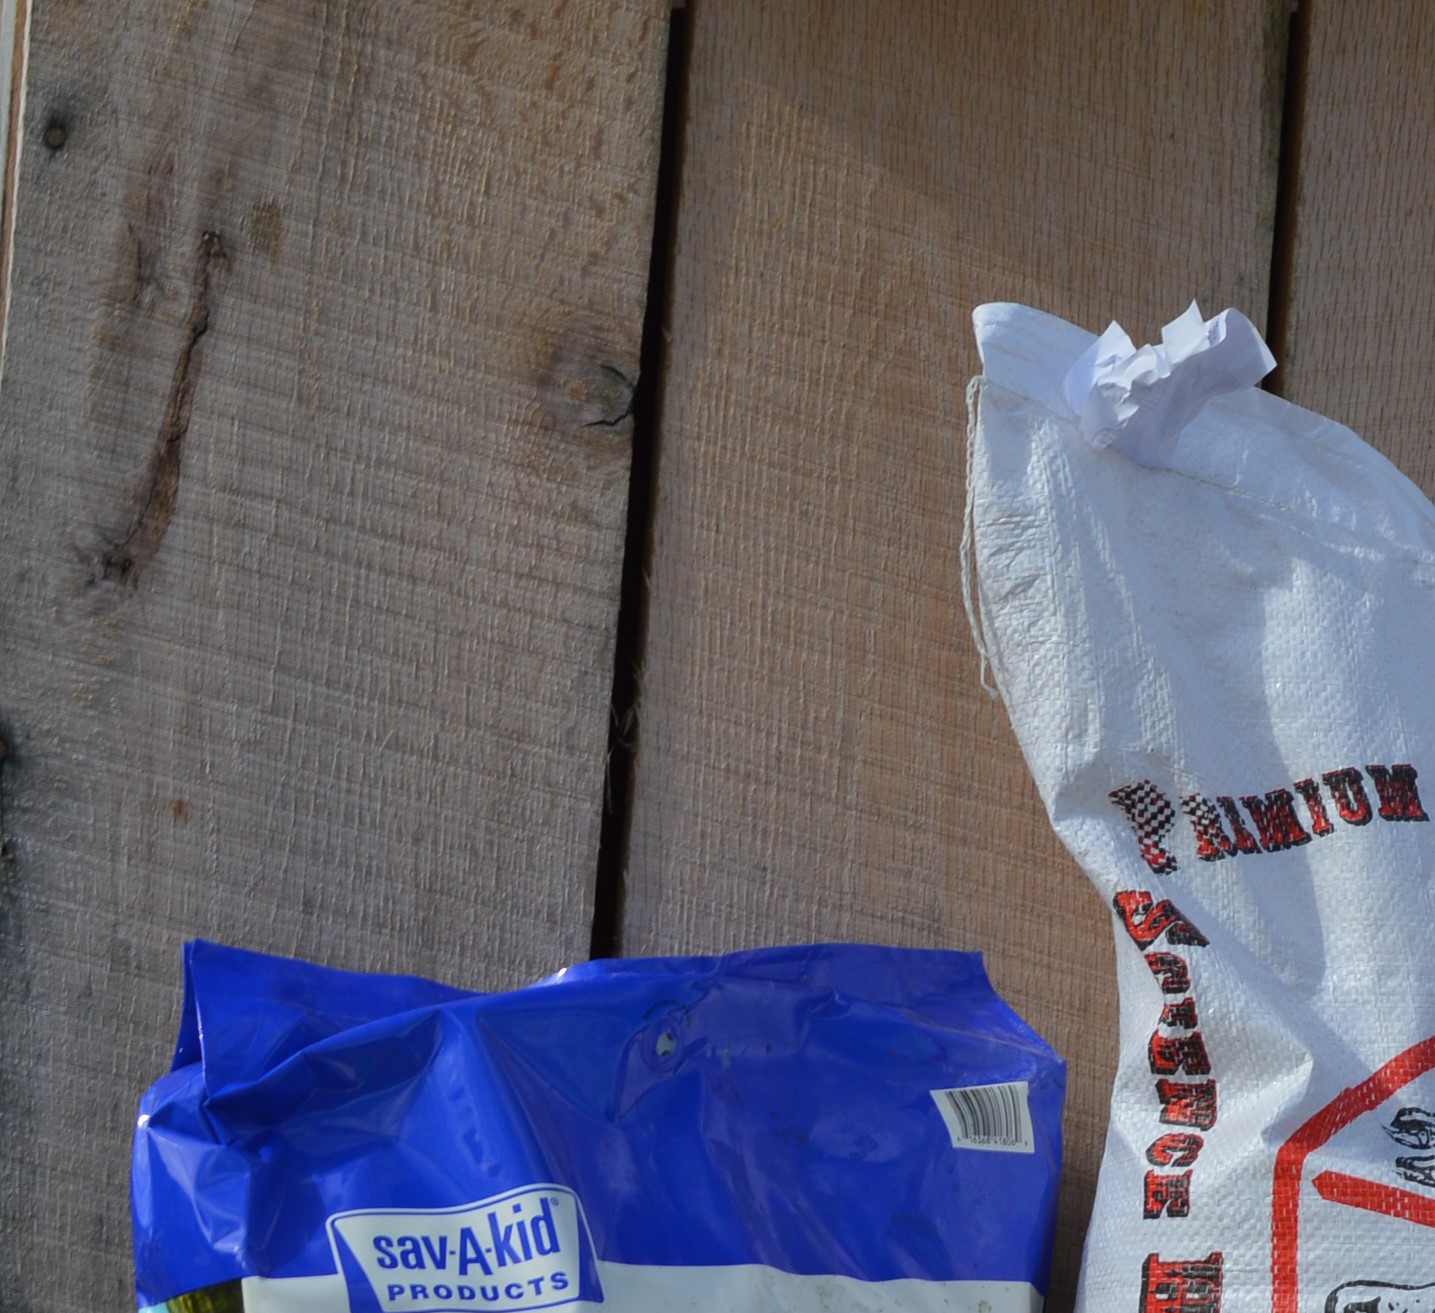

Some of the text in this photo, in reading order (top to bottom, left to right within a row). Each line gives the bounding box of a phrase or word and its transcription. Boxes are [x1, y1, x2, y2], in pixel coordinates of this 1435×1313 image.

[1113, 890, 1217, 1219] SCIENCE
[373, 1197, 561, 1276] sav-A-kid
[387, 1271, 569, 1302] PRODUCTS
